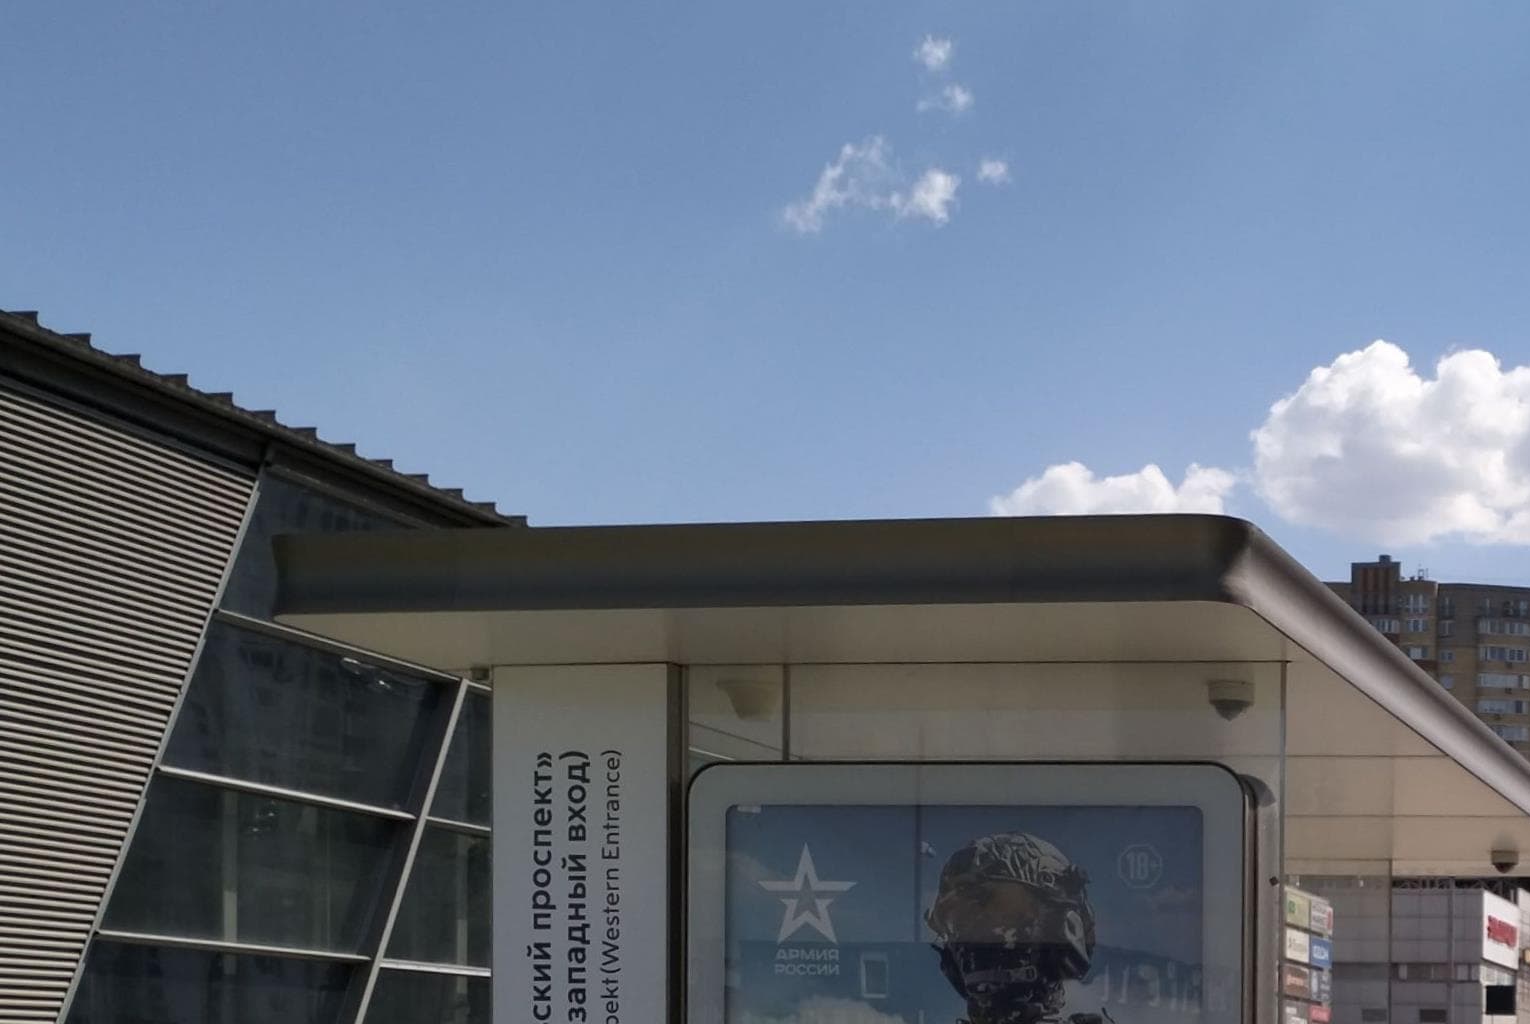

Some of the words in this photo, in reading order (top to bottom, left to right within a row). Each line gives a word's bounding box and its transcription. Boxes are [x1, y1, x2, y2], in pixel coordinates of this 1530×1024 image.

[531, 752, 556, 930] проспект»
[559, 750, 591, 841] вход)
[600, 750, 622, 860] Entrance)
[600, 867, 621, 974] (Western
[774, 964, 840, 976] РОССИИ
[775, 949, 839, 960] АРМИЯ
